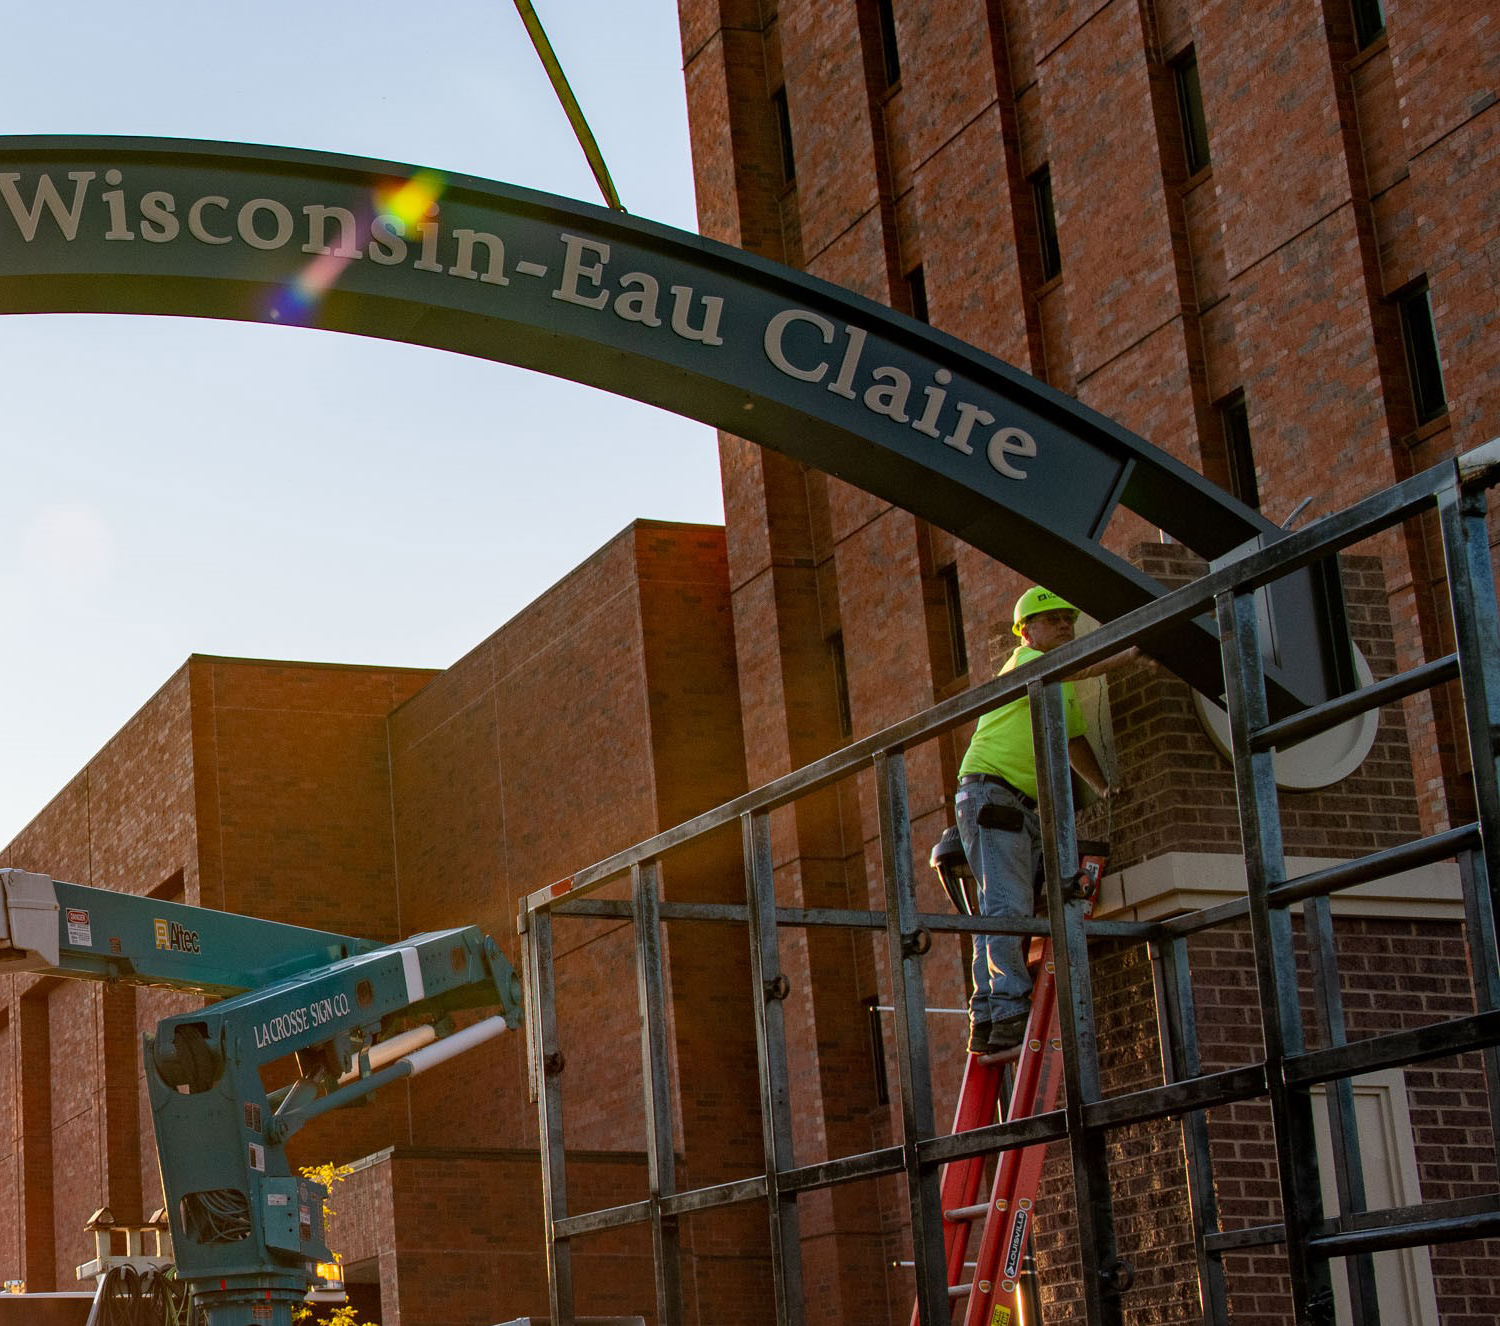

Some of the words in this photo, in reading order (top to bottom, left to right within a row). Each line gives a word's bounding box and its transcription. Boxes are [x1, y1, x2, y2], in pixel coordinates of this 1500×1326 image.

[764, 308, 1038, 481] Claire
[170, 922, 200, 953] Altec
[310, 998, 333, 1027] SIGN
[1009, 1212, 1025, 1266] LOUISVILLE
